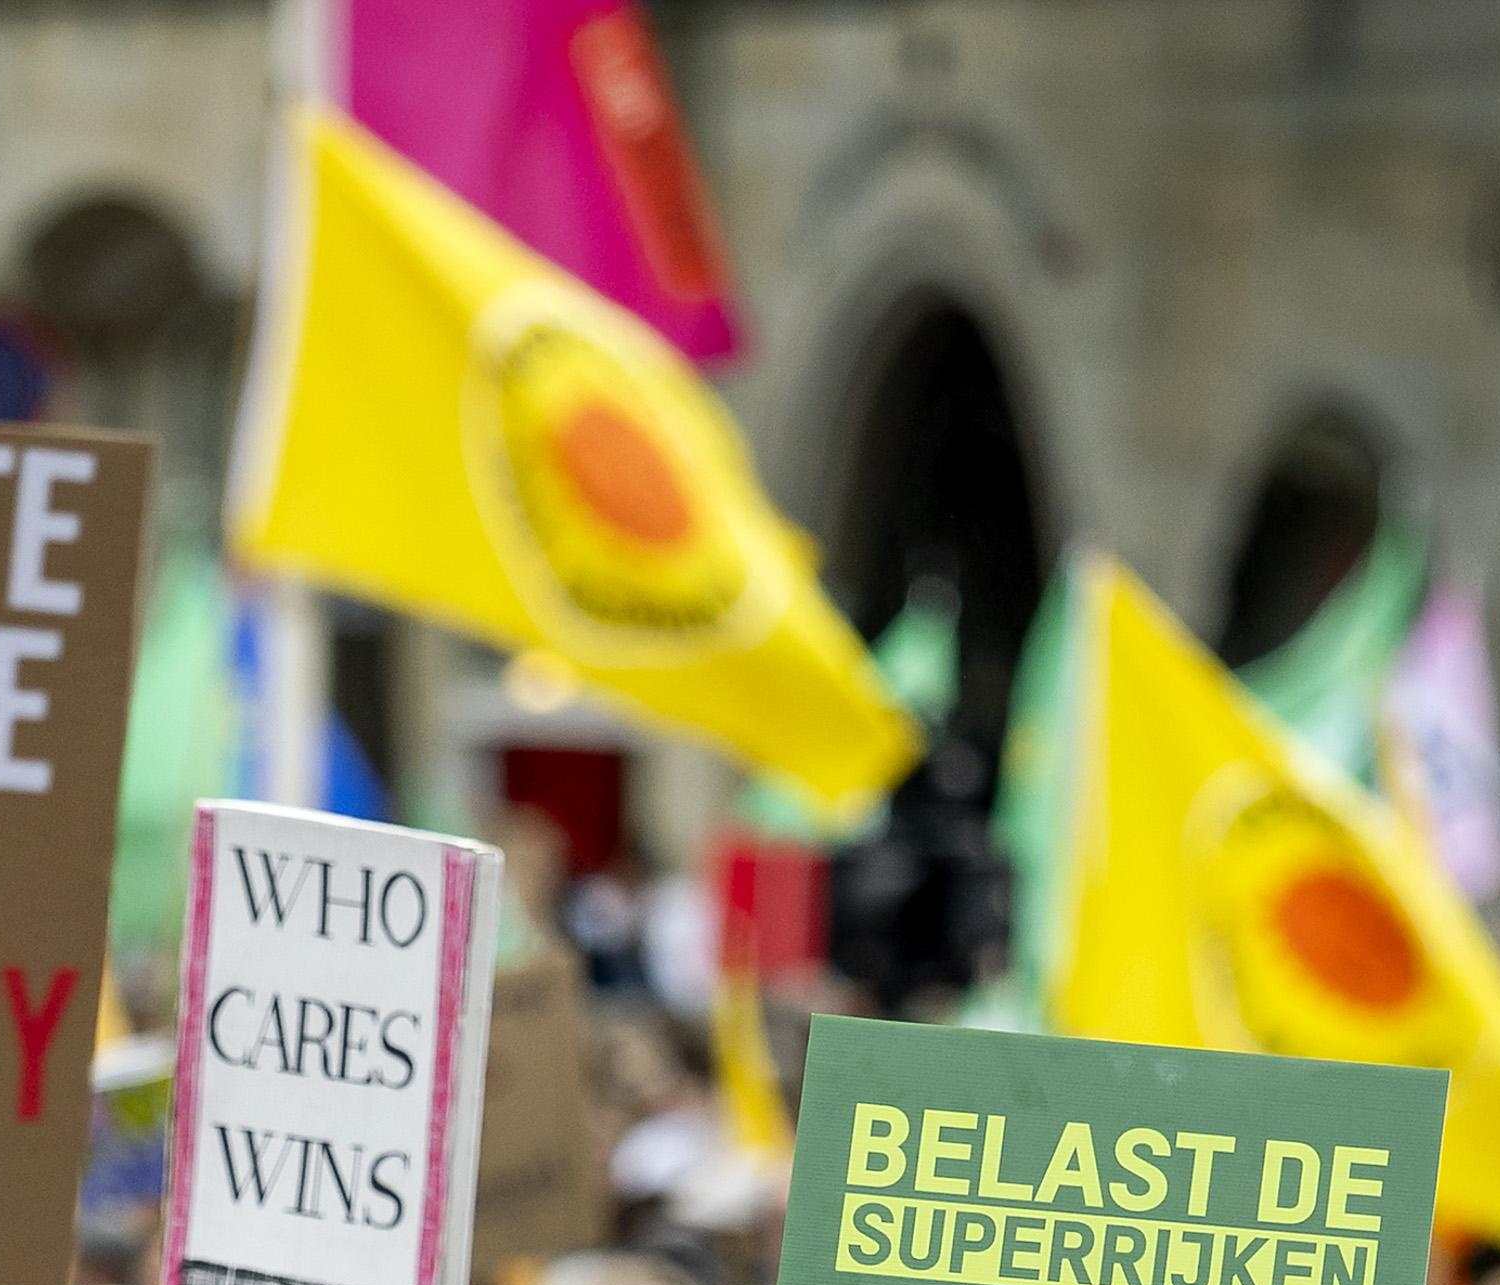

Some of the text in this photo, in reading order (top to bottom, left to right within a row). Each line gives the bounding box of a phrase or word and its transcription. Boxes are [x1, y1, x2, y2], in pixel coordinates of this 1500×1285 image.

[231, 846, 427, 948] WHO
[208, 985, 421, 1090] CARES
[214, 1125, 411, 1231] WINS
[846, 1102, 1390, 1233] BELAST DE
